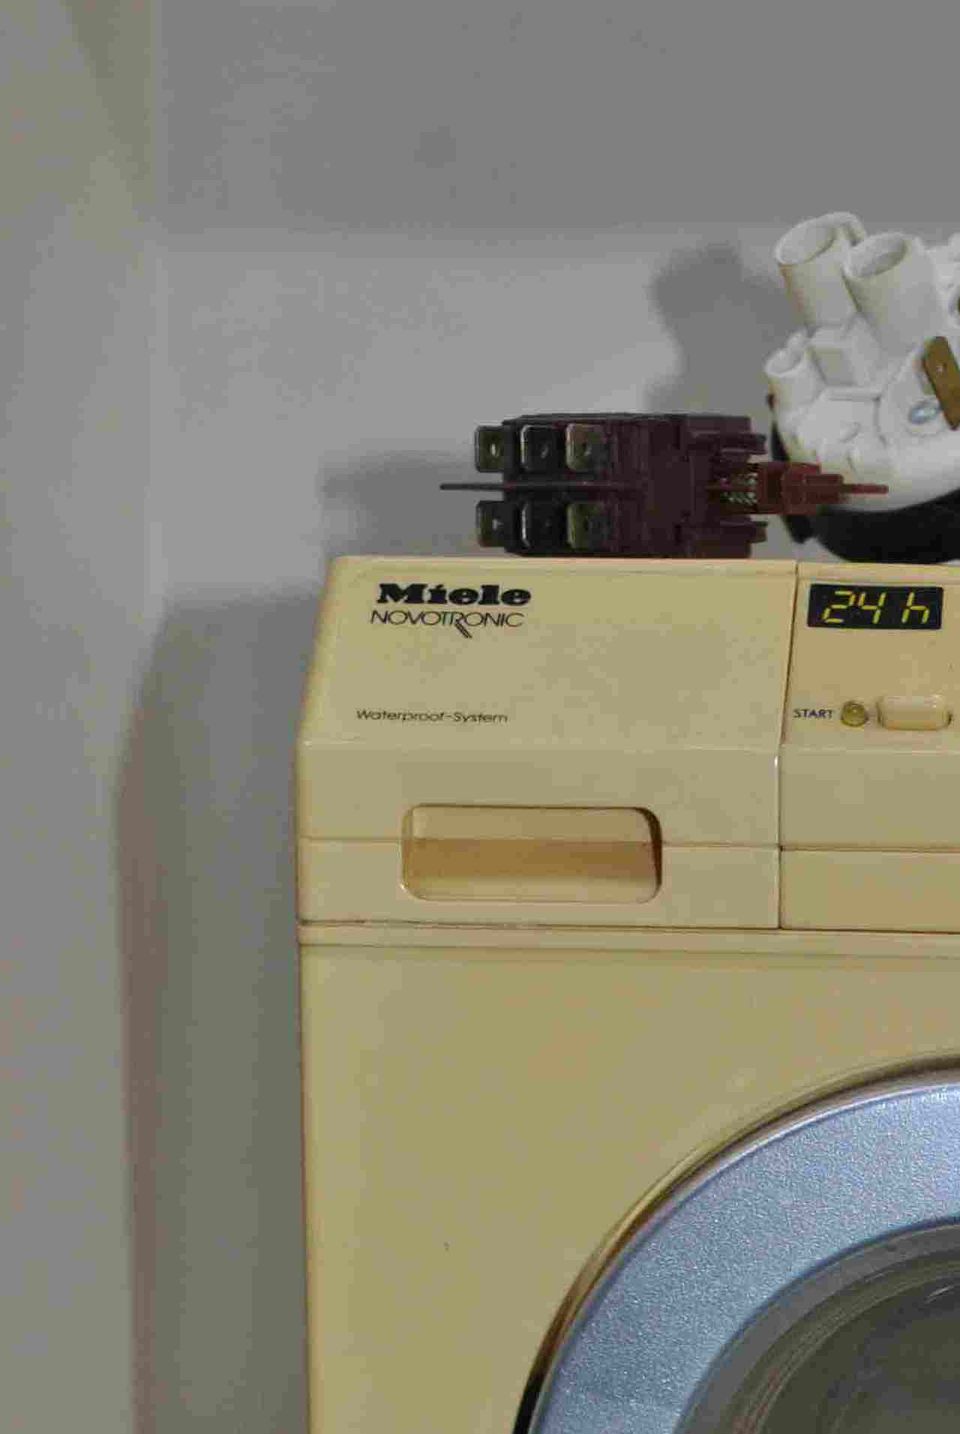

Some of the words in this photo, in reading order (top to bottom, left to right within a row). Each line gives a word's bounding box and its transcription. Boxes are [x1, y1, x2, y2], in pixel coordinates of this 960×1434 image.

[377, 583, 531, 606] Miele
[822, 590, 886, 624] 24
[901, 591, 930, 624] h
[370, 610, 525, 638] NOVOTRONIC
[356, 709, 508, 724] Waterproof-System
[793, 709, 833, 720] START
